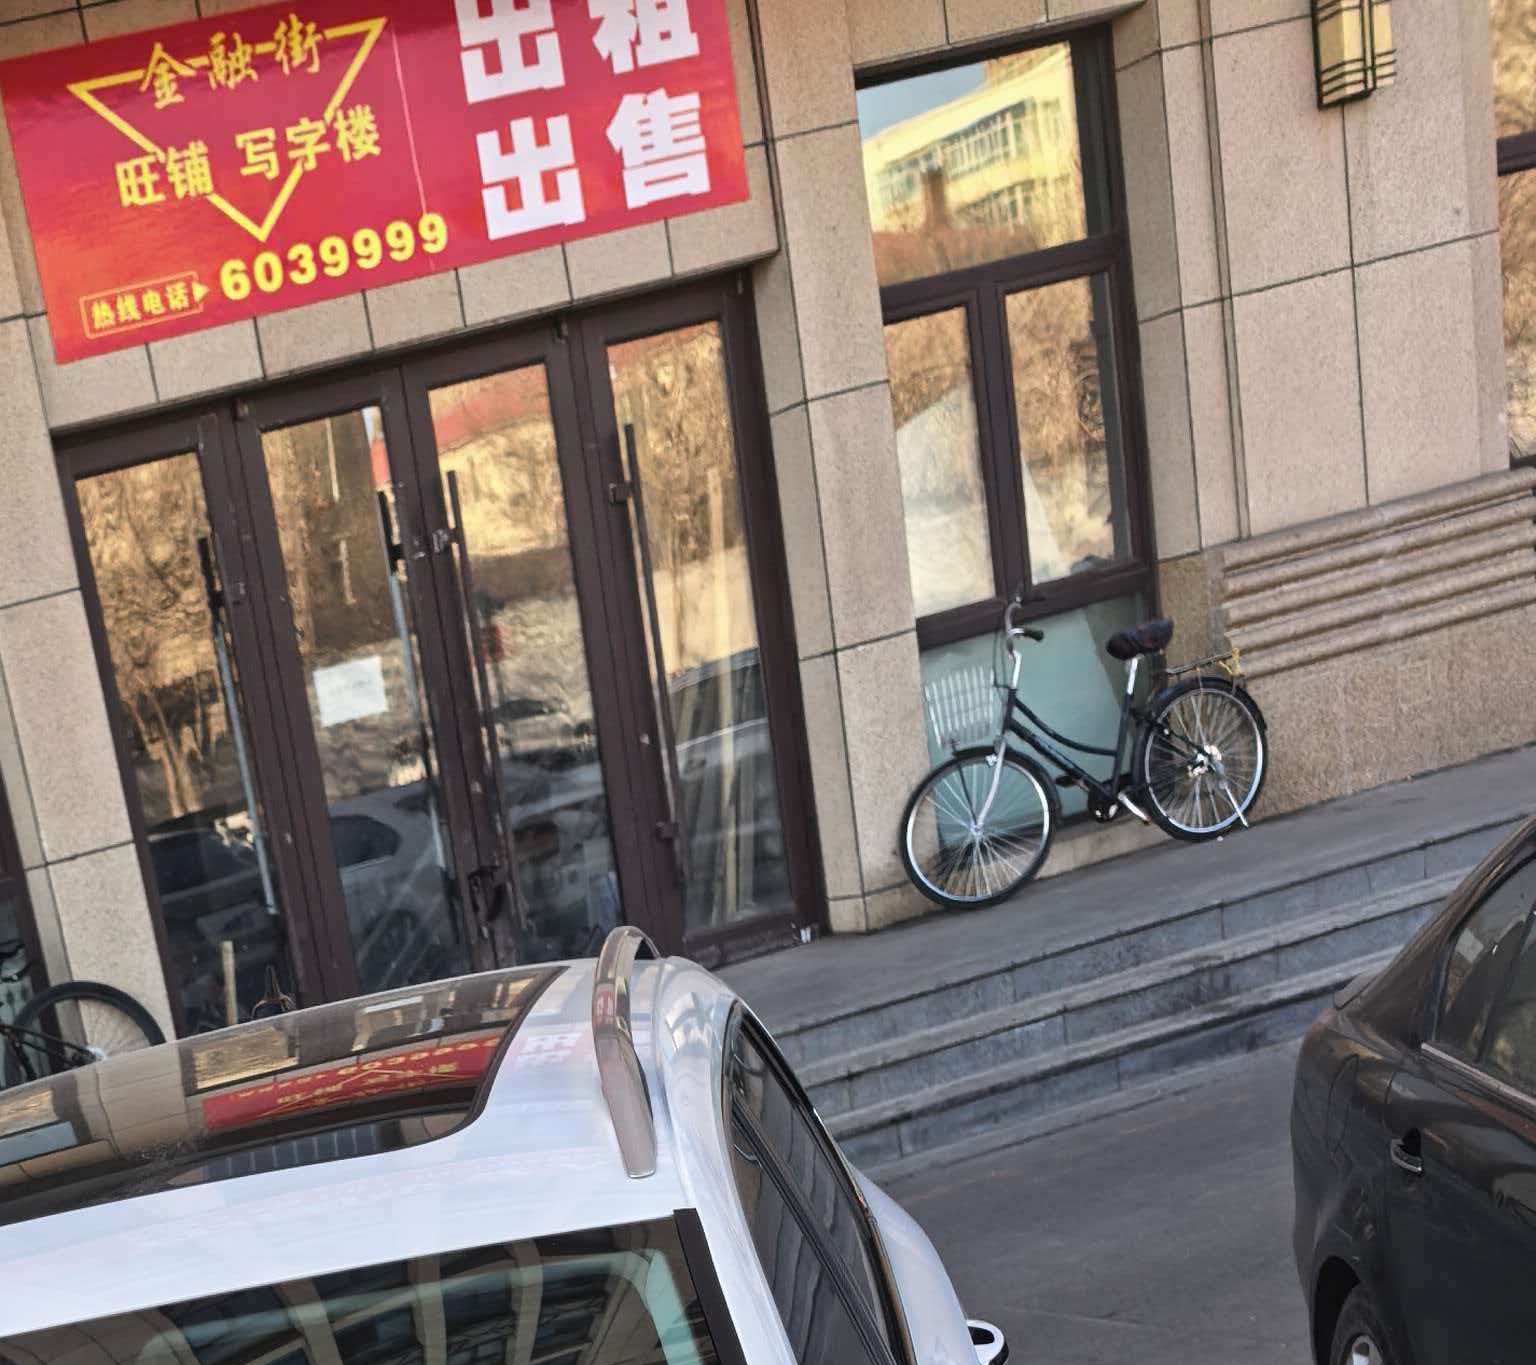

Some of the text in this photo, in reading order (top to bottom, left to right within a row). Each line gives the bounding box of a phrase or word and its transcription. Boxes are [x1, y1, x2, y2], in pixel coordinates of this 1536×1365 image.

[140, 13, 324, 109] 金融街
[453, 0, 700, 104] 出租
[115, 104, 381, 207] 旺铺 写字楼
[475, 87, 711, 240] 出售
[91, 212, 448, 330] 热线电话 6039999
